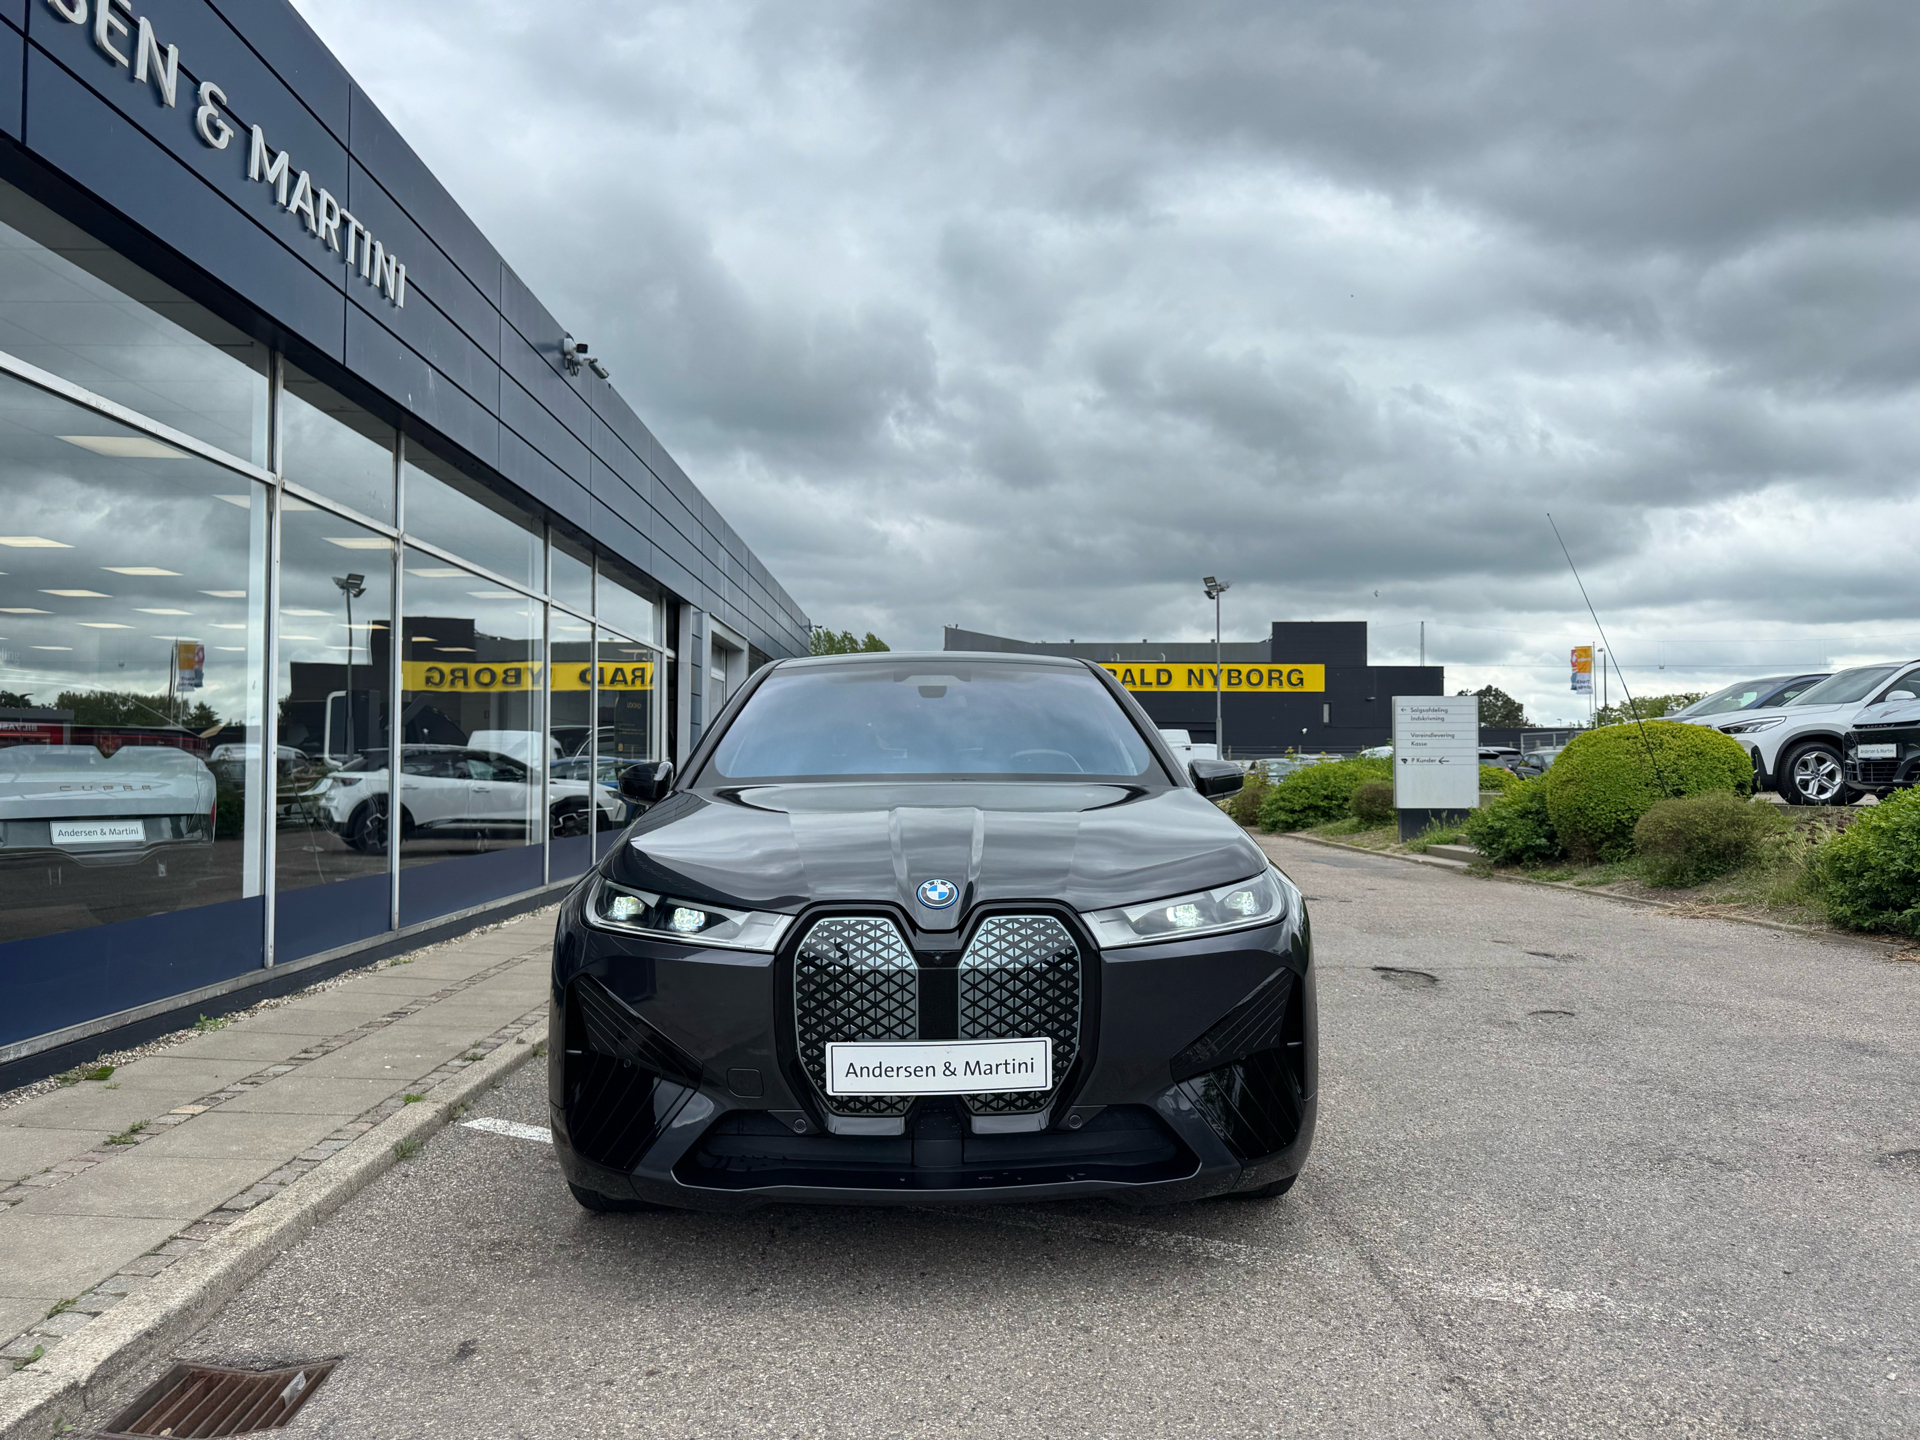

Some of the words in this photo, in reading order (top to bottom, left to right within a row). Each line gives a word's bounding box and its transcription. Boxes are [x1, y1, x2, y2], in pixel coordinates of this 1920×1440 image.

[197, 81, 234, 149] &
[248, 124, 406, 308] MARTINI
[1187, 668, 1304, 688] NYBORG
[58, 829, 98, 837] Andersen
[100, 828, 107, 836] &
[109, 827, 139, 836] Martini
[845, 1060, 936, 1078] Andersen
[942, 1061, 957, 1077] &
[964, 1057, 1035, 1076] Martini
